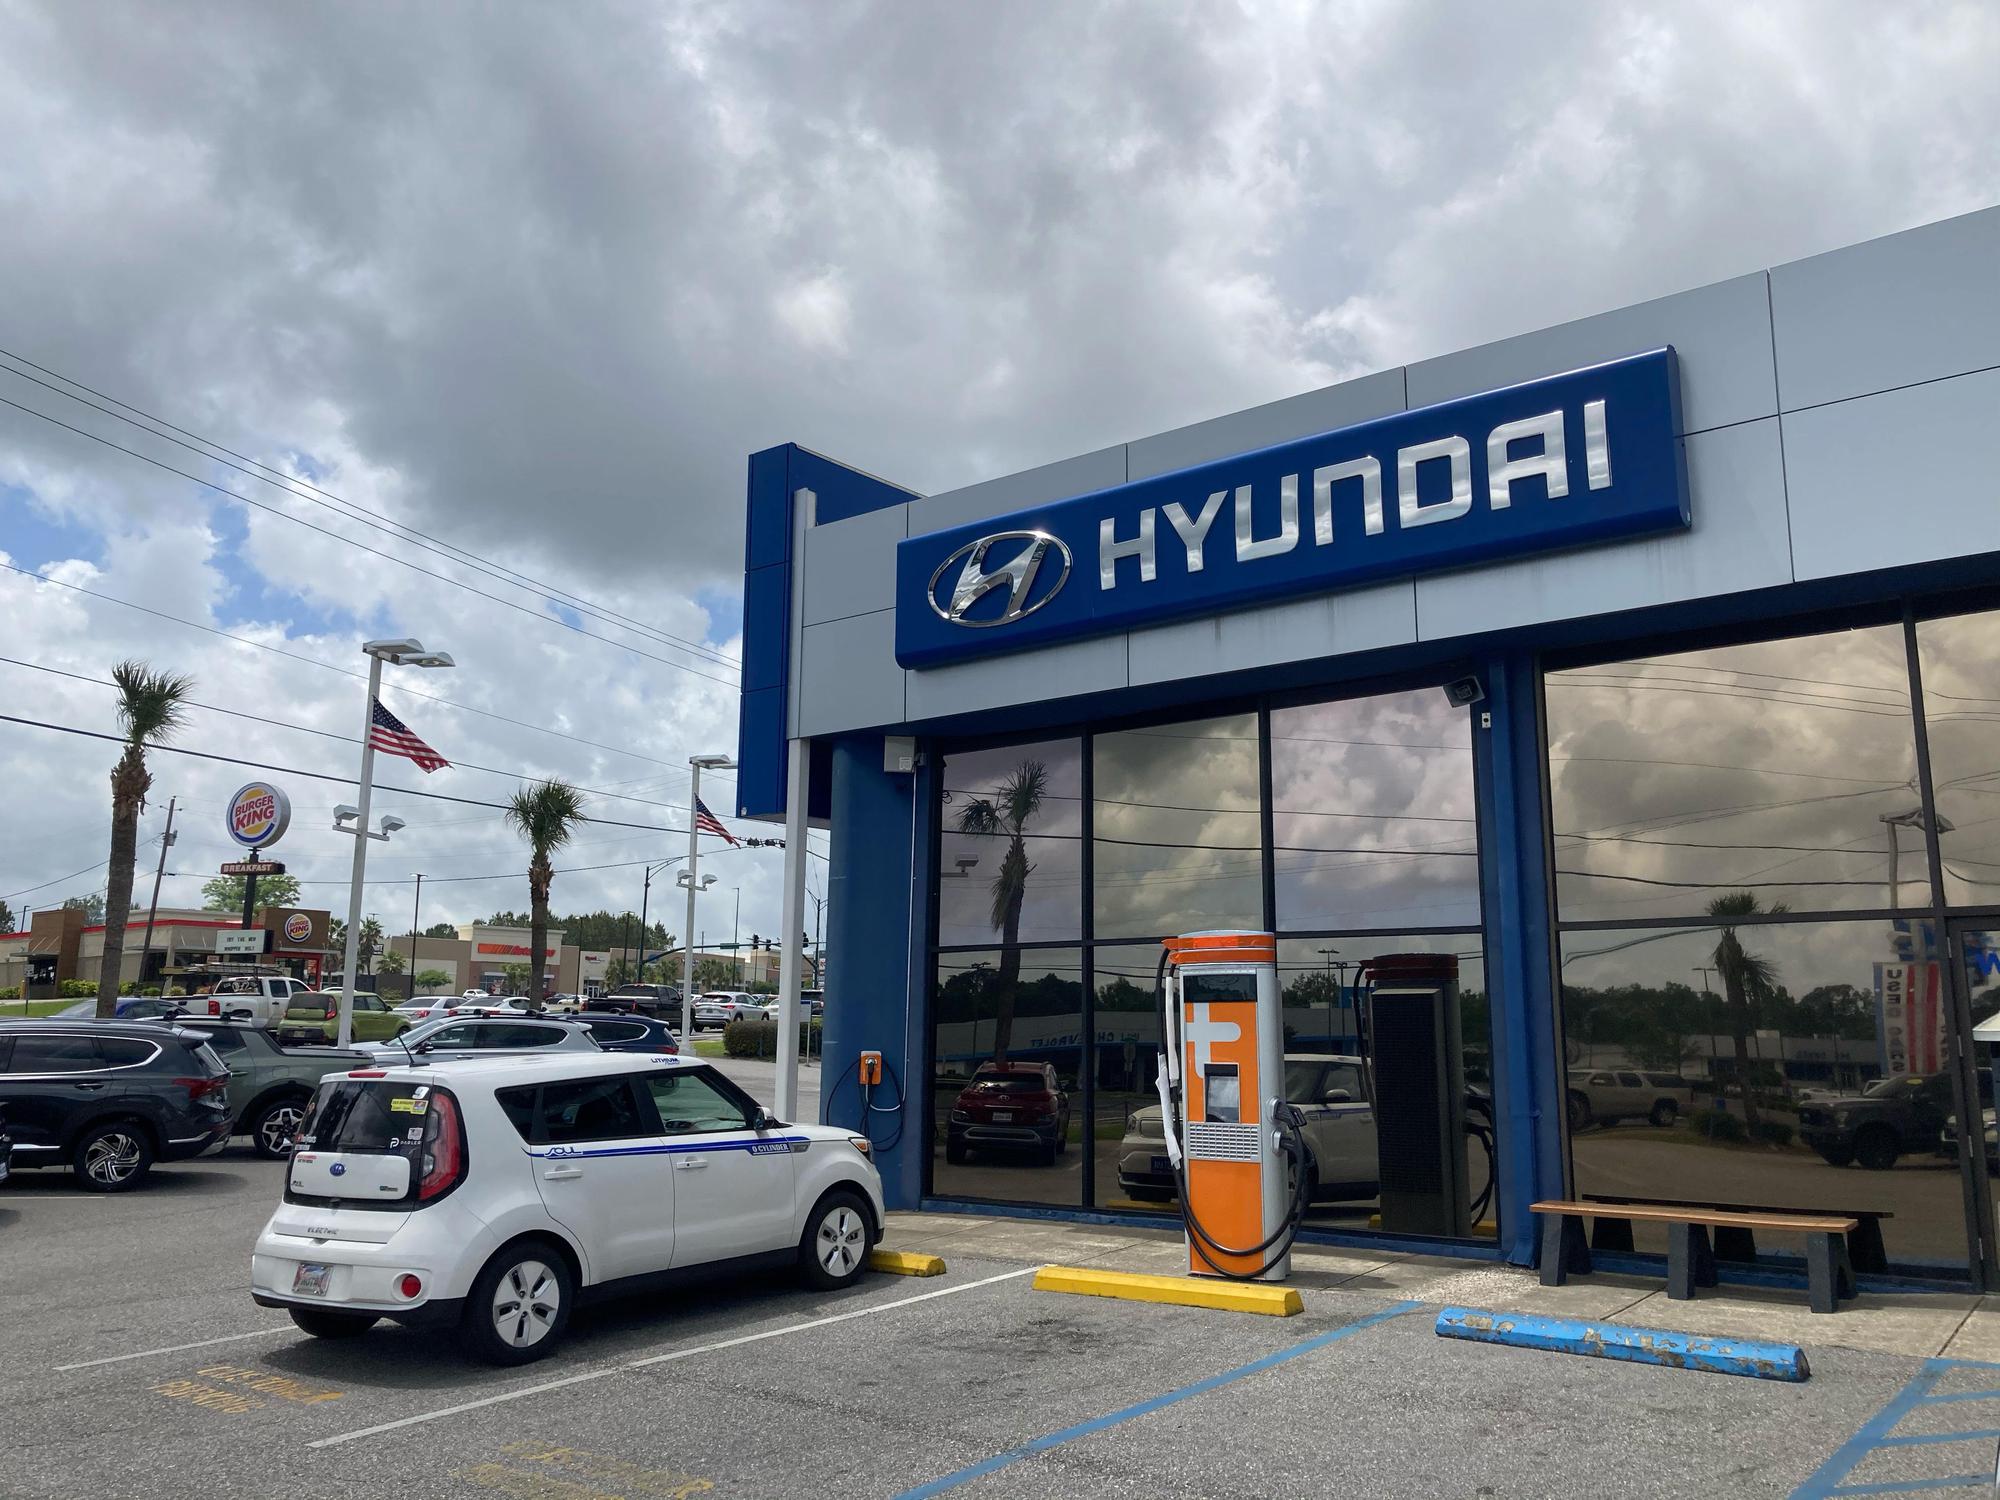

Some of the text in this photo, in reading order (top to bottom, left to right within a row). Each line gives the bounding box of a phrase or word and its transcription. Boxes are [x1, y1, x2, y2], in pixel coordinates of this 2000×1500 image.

[1098, 399, 1612, 591] HYUNDAI
[235, 795, 274, 818] BURGER
[235, 804, 275, 831] KING
[223, 864, 272, 873] BREAKFAST
[289, 920, 309, 928] BURGER
[289, 924, 310, 935] KING
[544, 1147, 582, 1156] SOUL
[758, 1143, 789, 1153] CYLINDER
[307, 1227, 339, 1235] ELECTRIC
